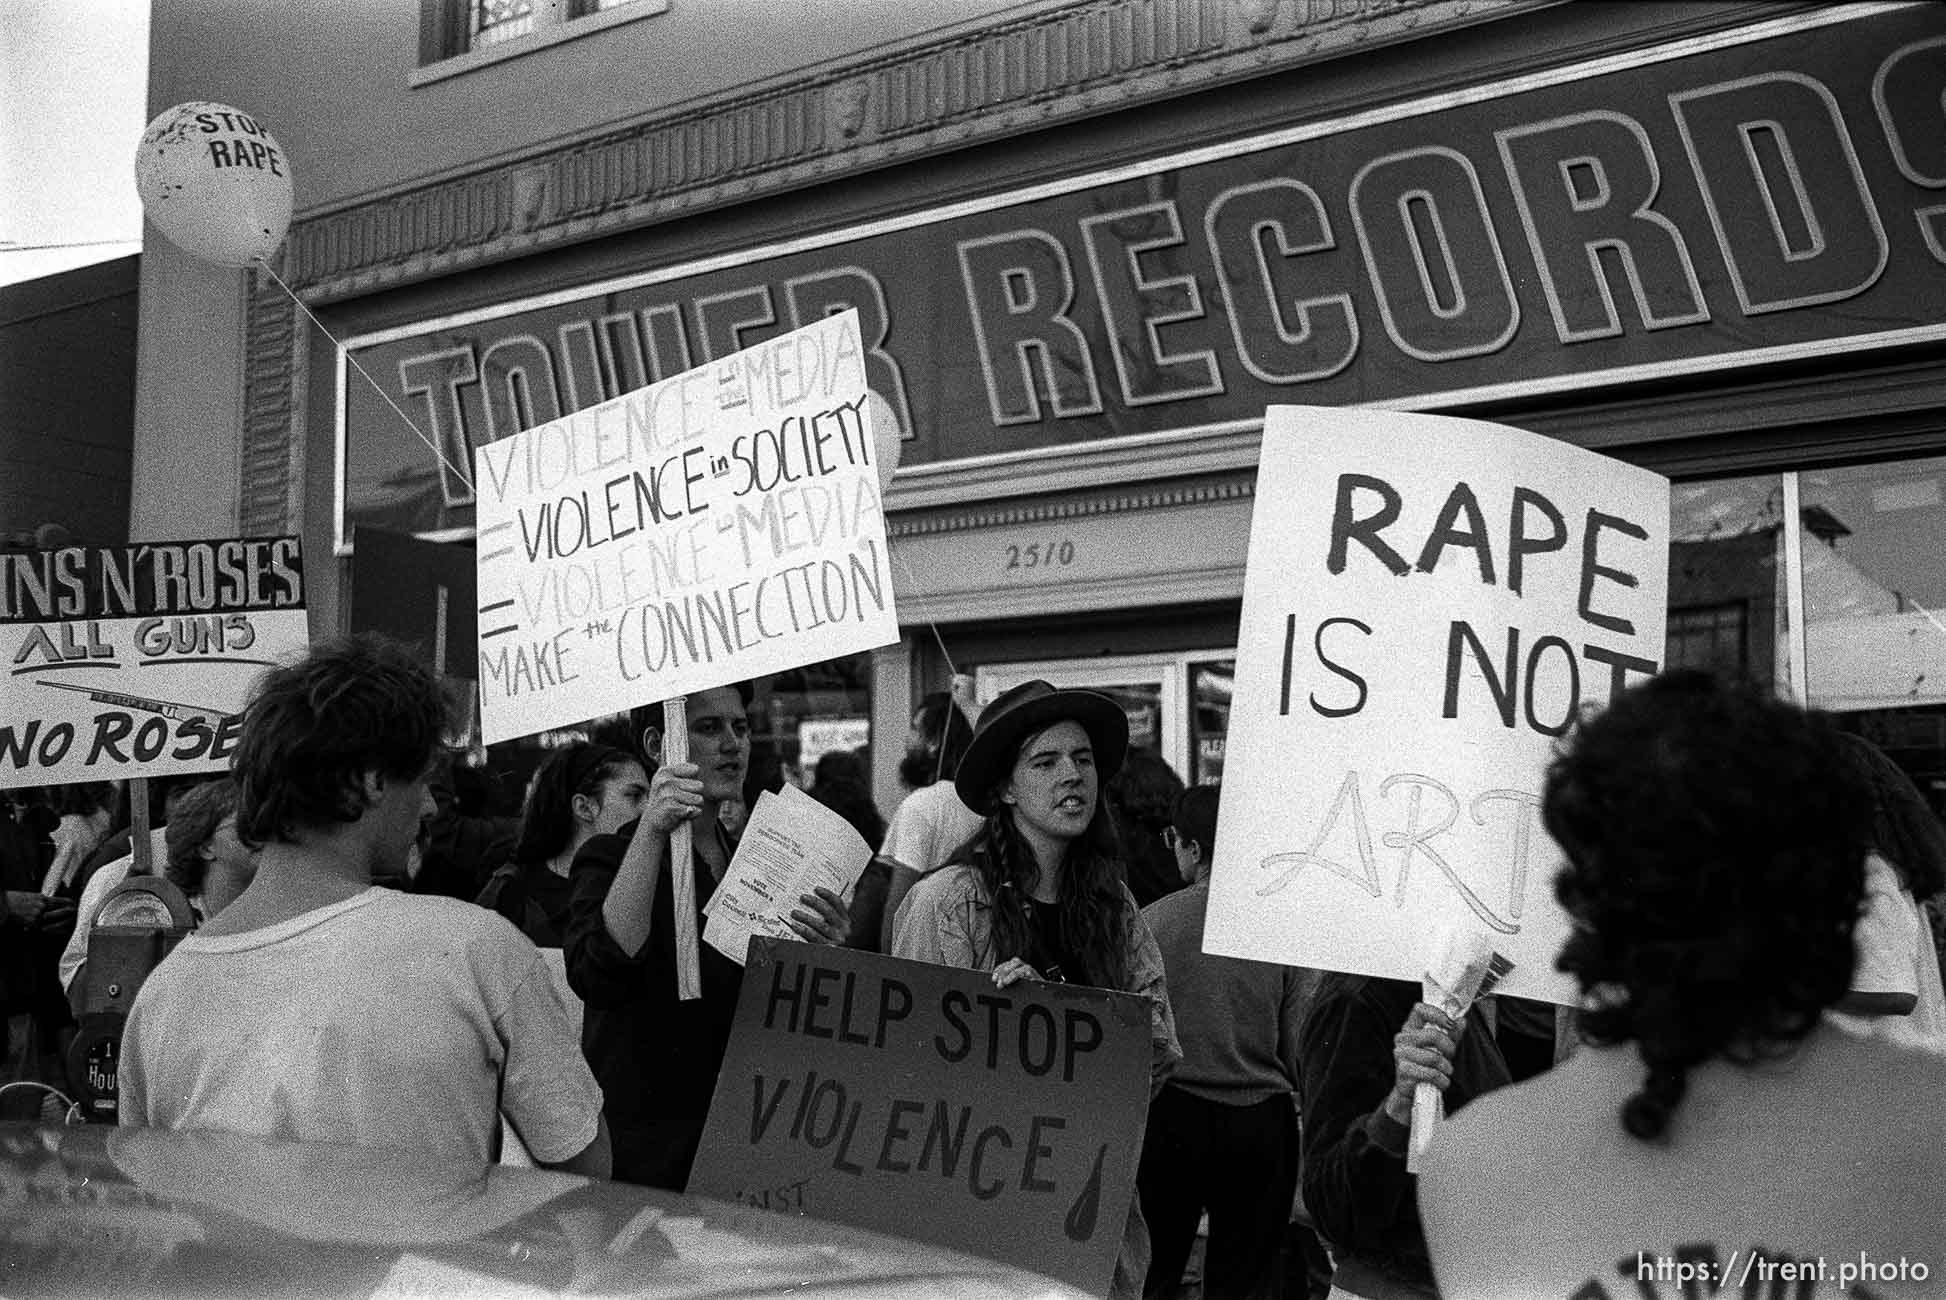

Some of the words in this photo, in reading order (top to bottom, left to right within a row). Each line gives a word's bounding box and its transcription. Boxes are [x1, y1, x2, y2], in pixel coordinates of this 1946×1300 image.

[195, 112, 267, 139] STOP
[209, 139, 283, 178] RAPE
[481, 372, 707, 502] VIOLENCE
[744, 318, 865, 416] MEDIA
[518, 446, 709, 563] VIOLENCE
[710, 454, 730, 479] in
[731, 393, 868, 497] SOCIETY
[518, 517, 714, 629] VIOLENCE
[736, 476, 884, 568] MEDIA
[1005, 540, 1076, 571] 2510
[1327, 473, 1650, 636] RAPE
[13, 619, 115, 664] ALL
[133, 615, 256, 656] GUNS
[480, 627, 581, 707] MAKE
[582, 621, 614, 641] the
[616, 540, 886, 681] CONNECTION
[1279, 613, 1374, 719] IS
[1442, 620, 1659, 737] NOT
[0, 718, 75, 769] NO
[1256, 770, 1543, 934] ART
[88, 1064, 120, 1091] HOU
[764, 960, 914, 1048] HELP
[934, 990, 1104, 1083] STOP
